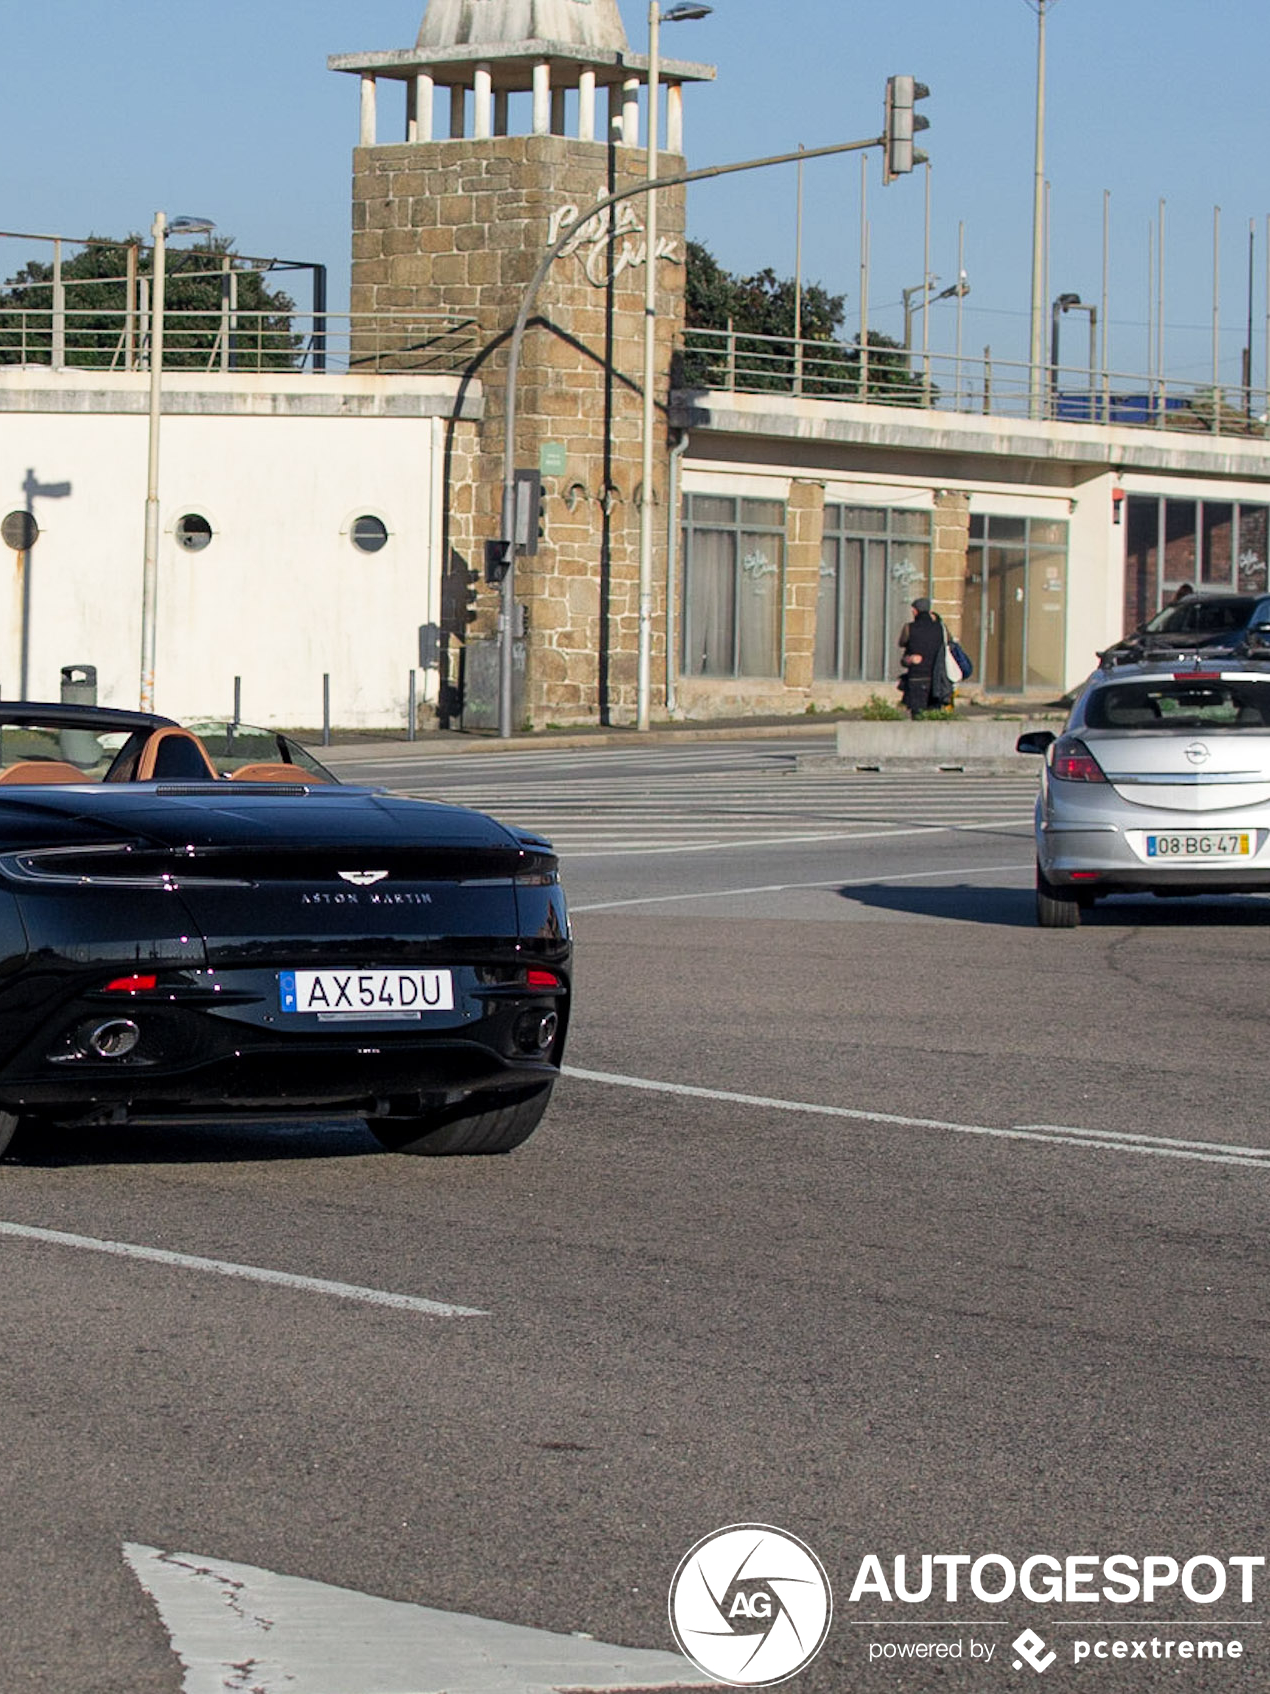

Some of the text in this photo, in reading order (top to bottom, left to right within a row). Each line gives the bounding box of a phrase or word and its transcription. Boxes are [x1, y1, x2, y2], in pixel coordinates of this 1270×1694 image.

[301, 893, 432, 903] ASTON MARTIN
[308, 975, 440, 1007] AX54DU
